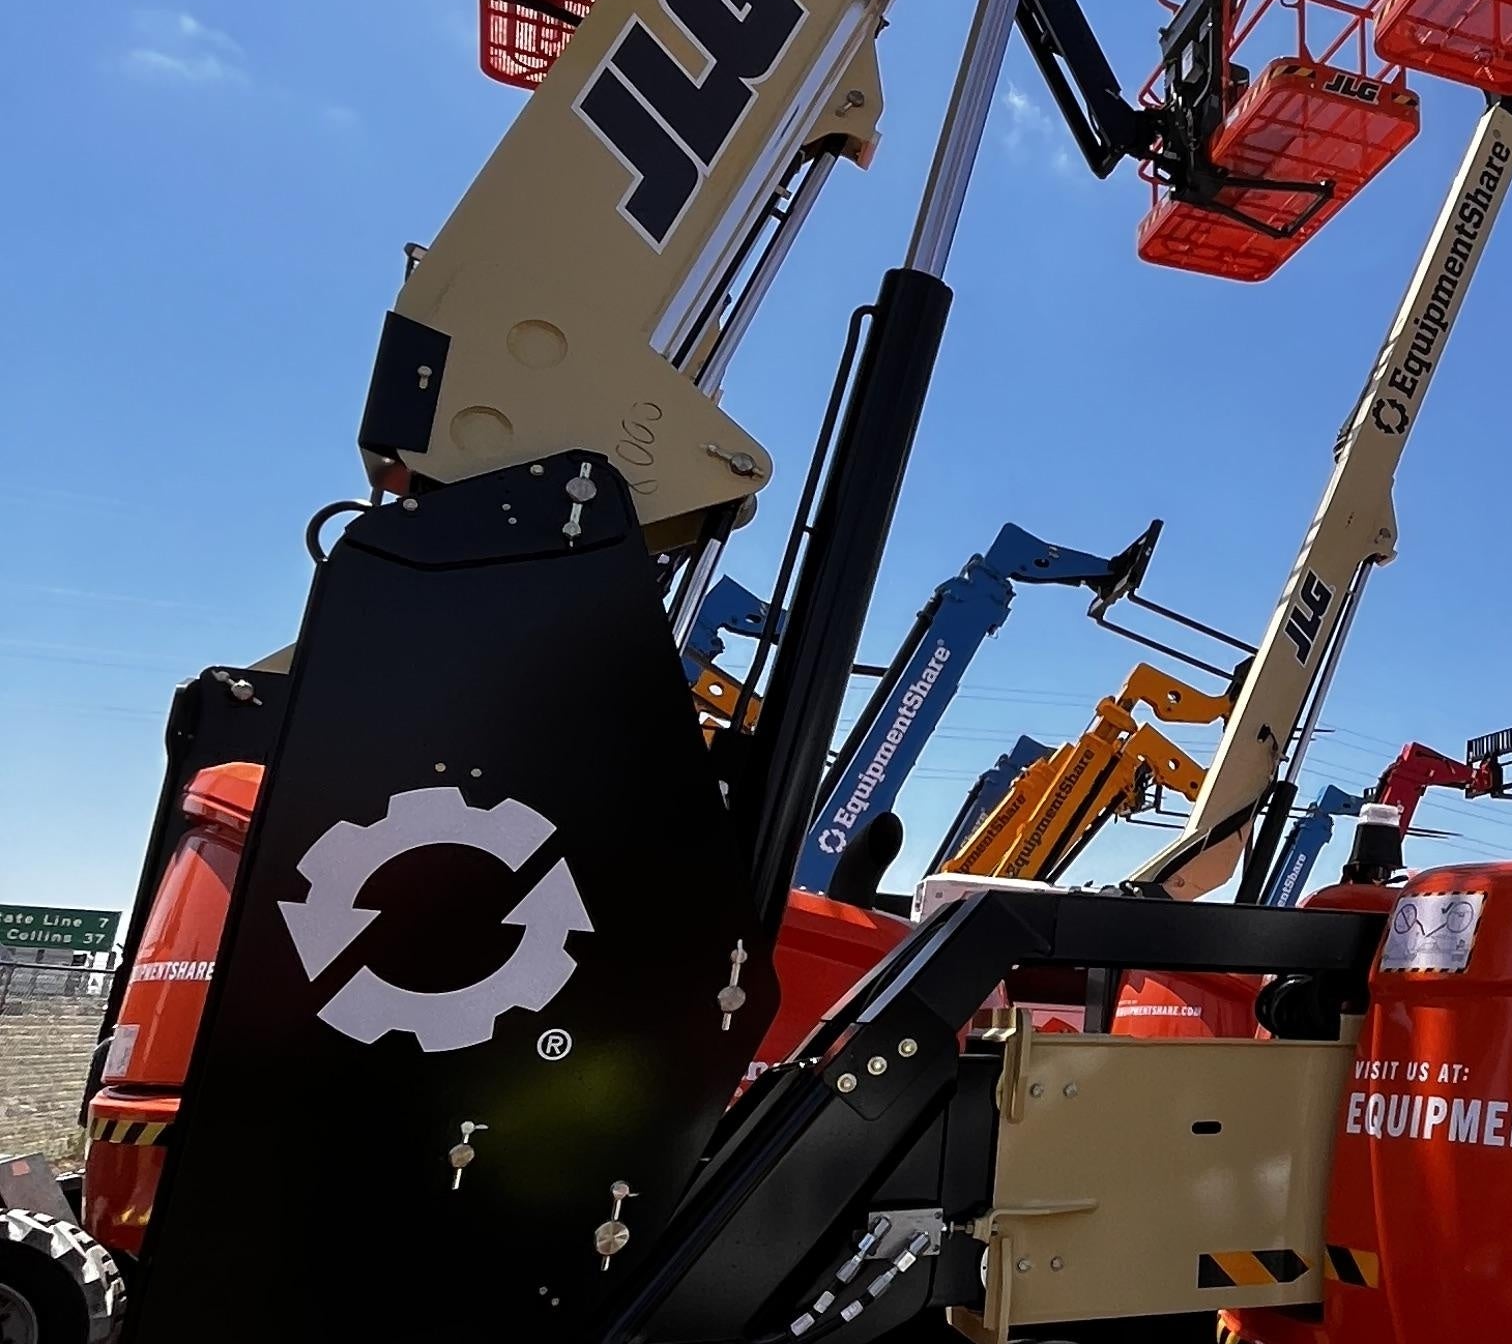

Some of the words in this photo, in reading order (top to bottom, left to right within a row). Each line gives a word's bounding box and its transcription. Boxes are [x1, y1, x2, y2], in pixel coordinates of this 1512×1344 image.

[1323, 72, 1382, 104] JLG
[1389, 141, 1511, 398] EquipmentShare
[1283, 567, 1334, 668] JLG
[833, 644, 951, 828] EquipmentShare
[0, 912, 34, 924] ate
[43, 914, 82, 927] Line
[99, 918, 109, 928] 7
[7, 928, 72, 943] Collins
[82, 933, 106, 944] 37
[1355, 1060, 1399, 1080] VISIT
[1406, 1061, 1430, 1082] US
[1438, 1063, 1469, 1084] AT:
